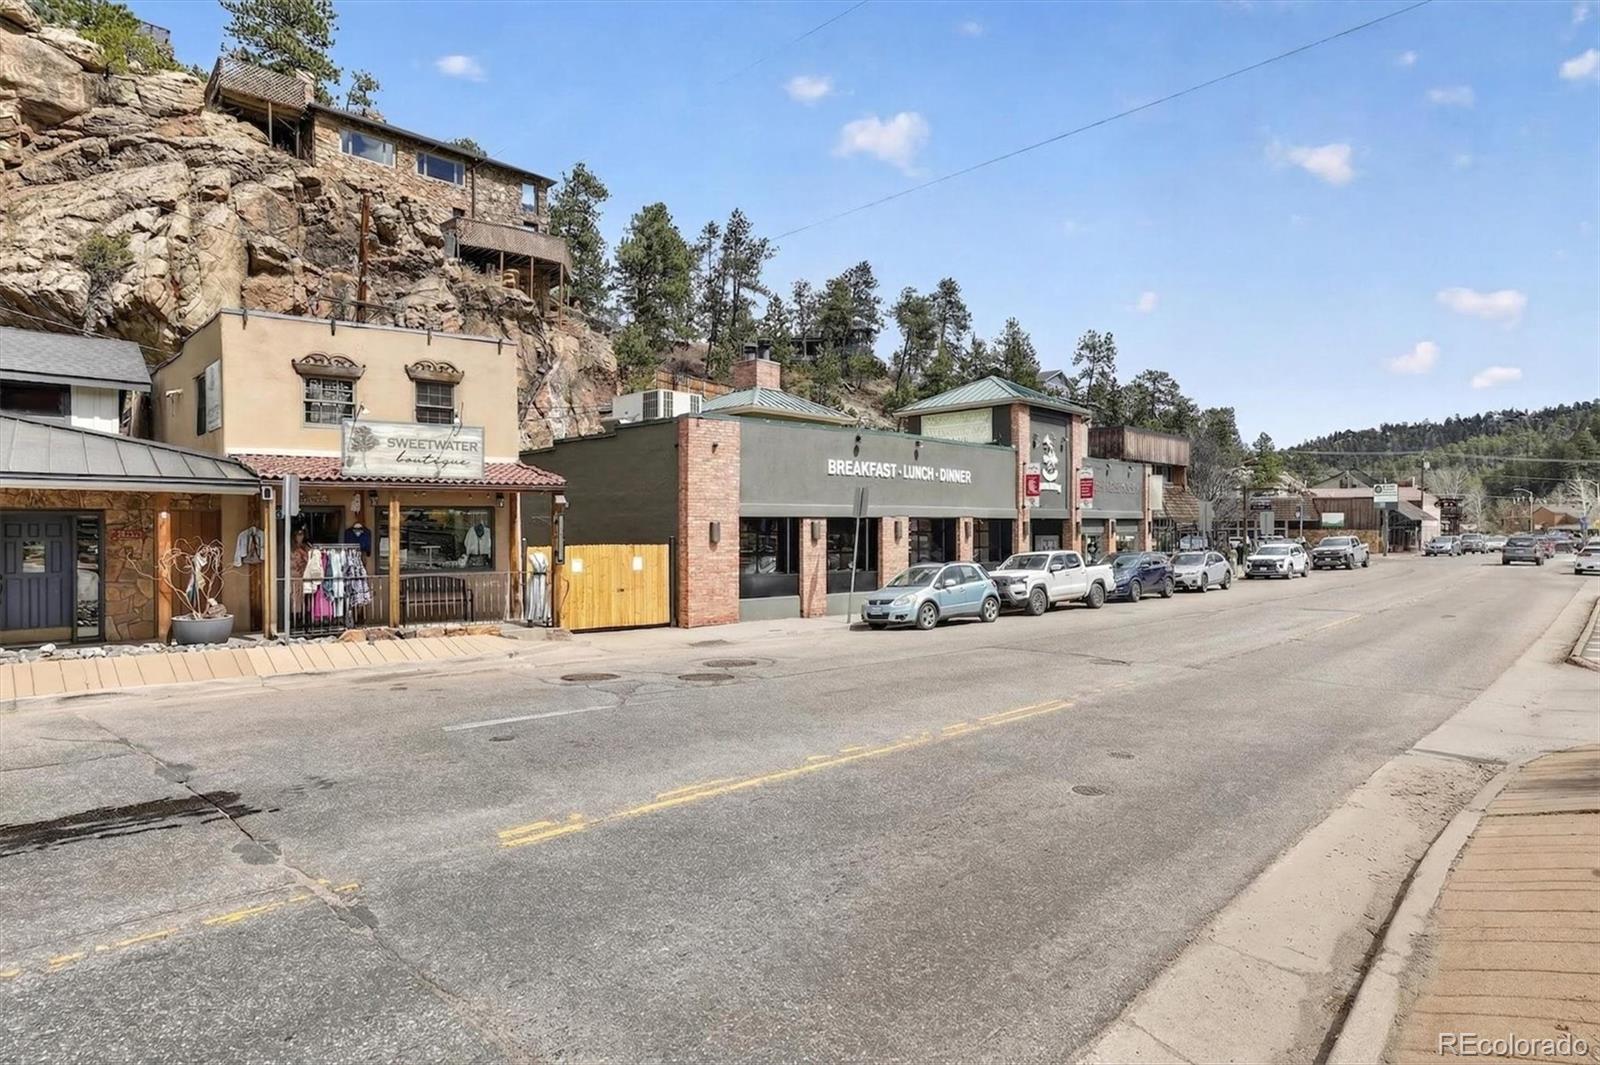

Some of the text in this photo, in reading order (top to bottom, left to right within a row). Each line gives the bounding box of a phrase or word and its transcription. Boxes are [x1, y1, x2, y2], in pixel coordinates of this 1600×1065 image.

[387, 437, 478, 452] SWEETWATER
[396, 450, 471, 469] boutique
[827, 459, 972, 484] BREAKFAST LUNCH DINNER
